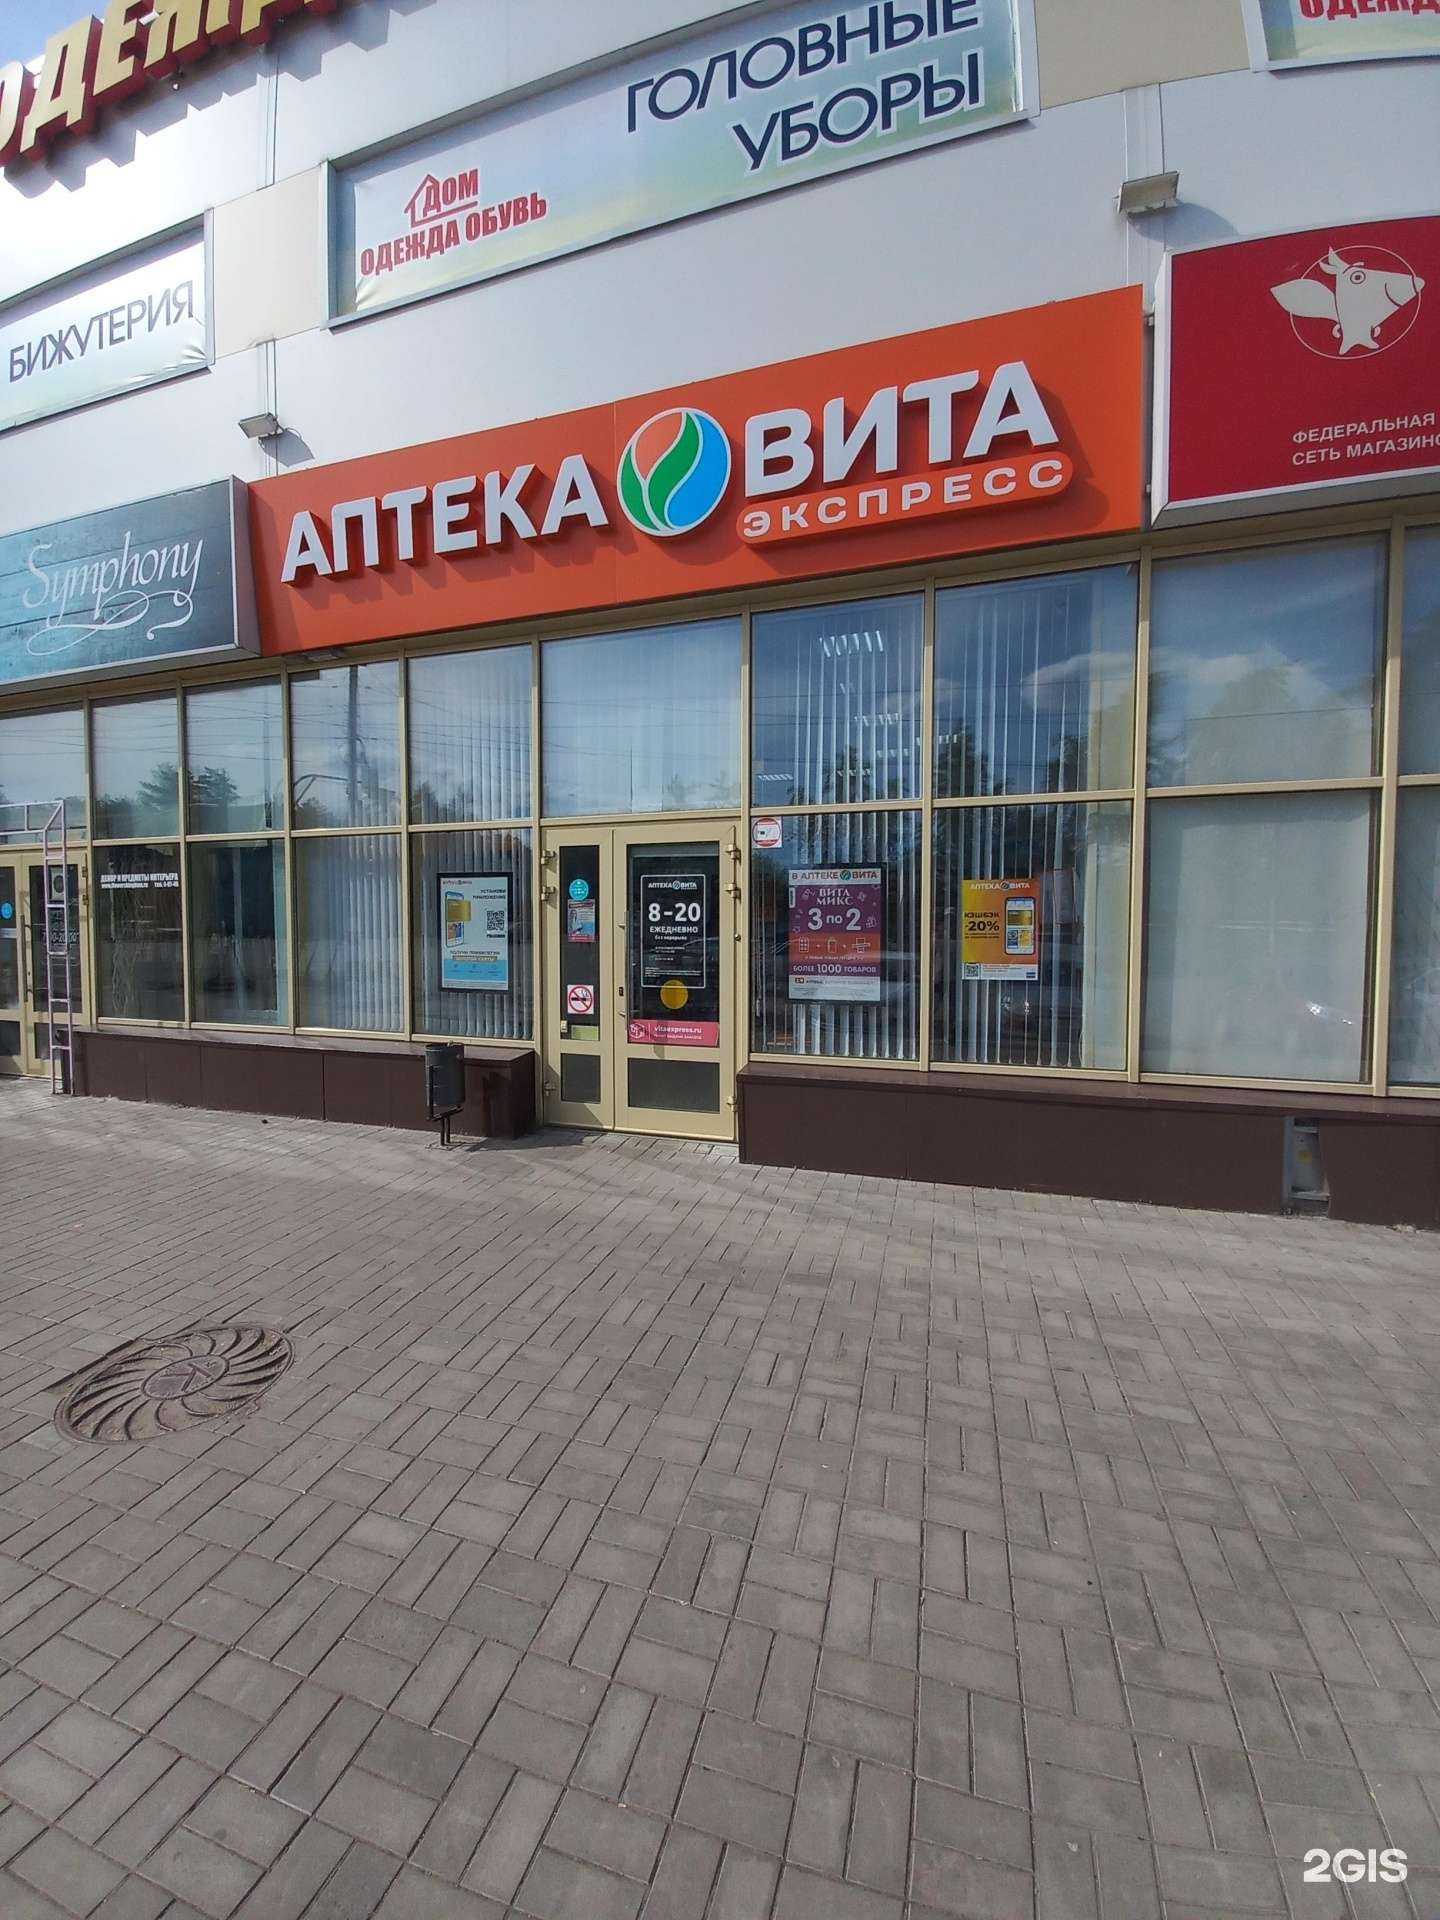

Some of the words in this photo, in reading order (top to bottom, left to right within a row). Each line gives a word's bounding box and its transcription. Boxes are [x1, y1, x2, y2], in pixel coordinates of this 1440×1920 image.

[627, 0, 979, 134] ГОЛОВНЫЕ
[732, 52, 980, 171] УБОРЫ
[422, 168, 479, 217] ДОМ
[360, 218, 459, 277] ОДЕЖДА
[465, 191, 548, 242] ОБУВЬ
[9, 279, 194, 384] БИЖУТЕРИЯ
[1292, 412, 1436, 444] ФЕДЕРАЛЬНАЯ
[1292, 446, 1341, 466] СЕТЬ
[280, 453, 610, 585] АПТЕКА
[744, 360, 1060, 496] ВИТА
[742, 458, 1065, 538] ЭКСПРЕСС
[22, 530, 204, 628] Symphony
[801, 871, 839, 880] АПТЕКЕ
[852, 870, 877, 879] ВИТА
[649, 926, 699, 935] ЕЖЕДНЕВНО
[807, 907, 823, 931] 3
[826, 914, 843, 924] по
[846, 907, 862, 931] 2
[817, 963, 842, 973] 1000
